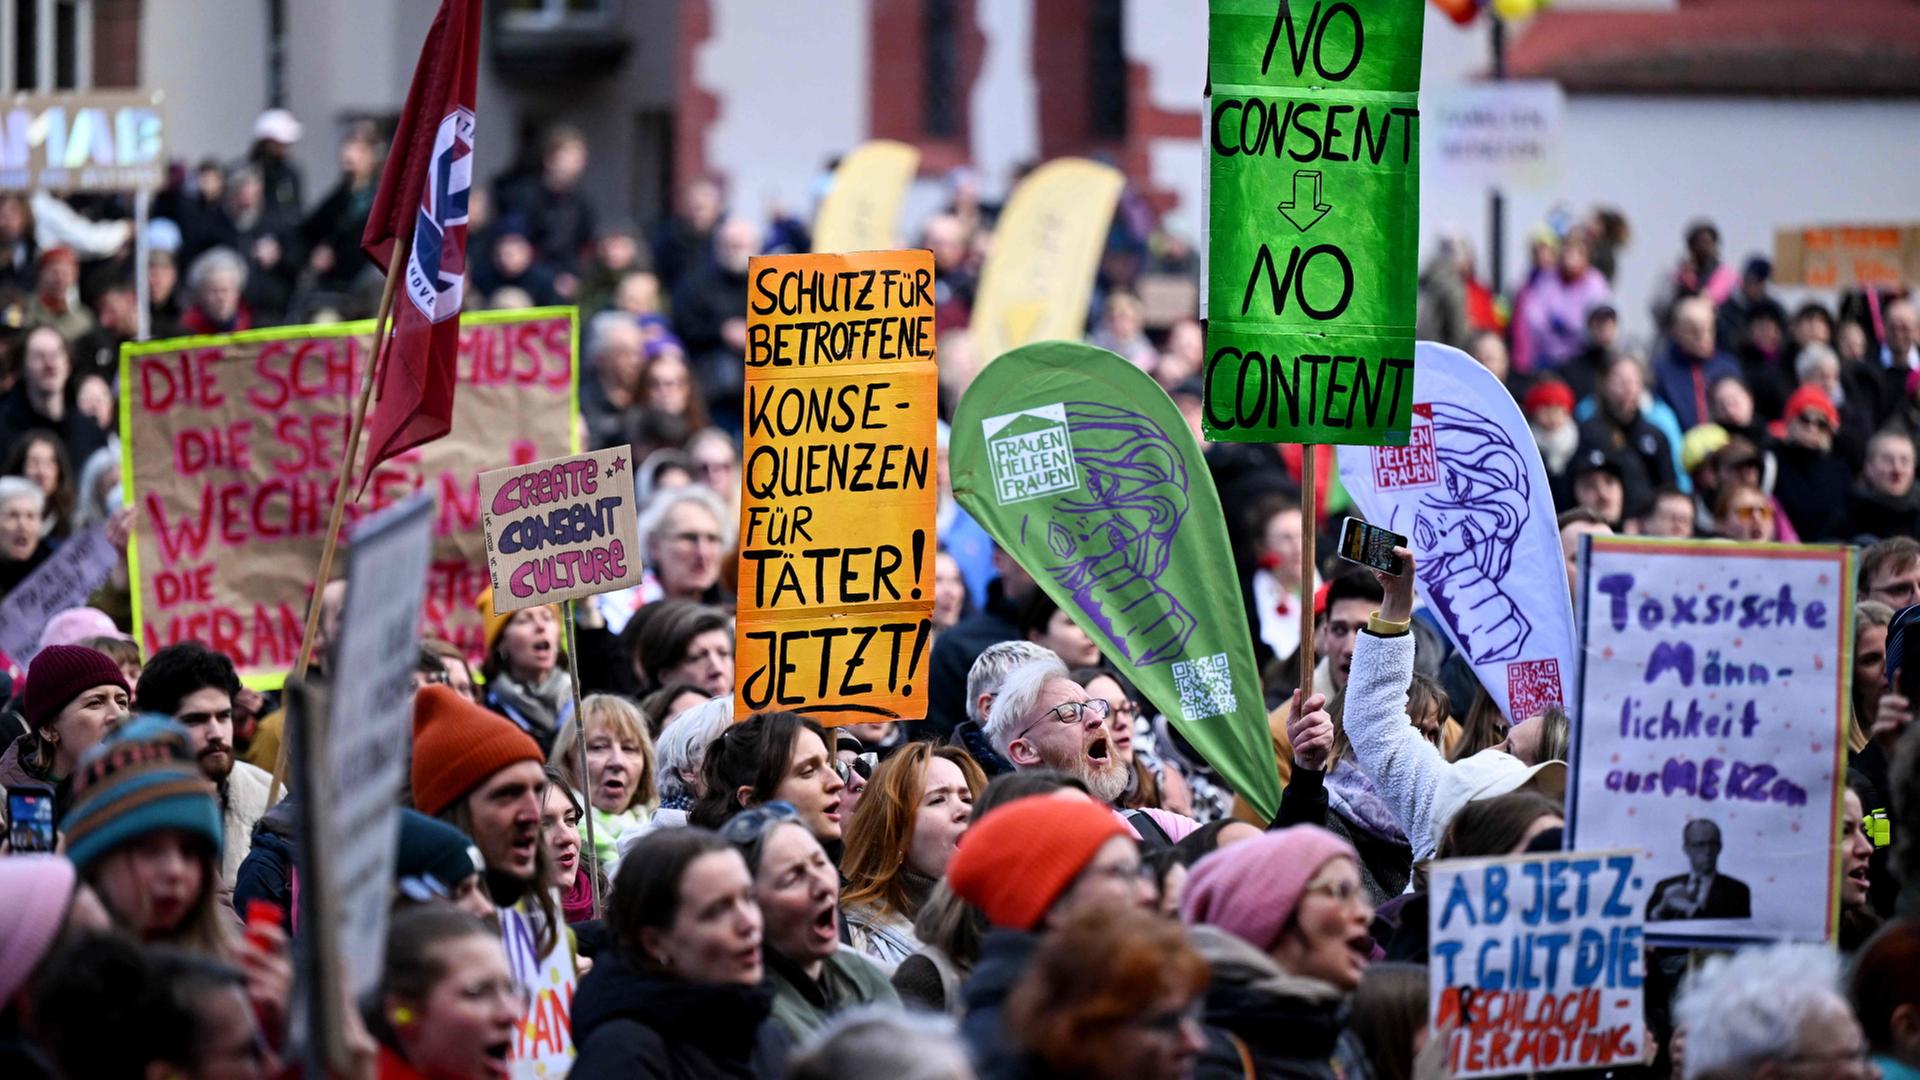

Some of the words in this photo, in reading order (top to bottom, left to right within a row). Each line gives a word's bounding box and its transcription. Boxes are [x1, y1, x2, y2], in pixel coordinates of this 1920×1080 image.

[1261, 0, 1364, 81] NO
[1211, 97, 1419, 165] CONSENT
[751, 268, 876, 315] SCHUTZ
[1242, 244, 1354, 320] NO
[141, 349, 225, 414] DIE
[247, 335, 361, 411] SCH
[456, 317, 571, 392] MUSS
[746, 316, 934, 367] BETROFFENE,
[1204, 346, 1414, 430] CONTENT
[176, 420, 252, 476] DIE
[747, 443, 929, 499] QUENZEN
[995, 430, 1062, 460] FRAUEN
[997, 450, 1067, 478] HELFEN
[1376, 446, 1432, 468] HELFEN
[1002, 467, 1071, 498] FRAUEN
[1379, 464, 1435, 487] FRAUEN
[747, 506, 812, 547] FÜR
[153, 563, 216, 609] DIE
[742, 529, 925, 608] TÄTER!
[1597, 572, 1827, 633] Toxsische
[742, 618, 931, 710] JETZT!
[1644, 641, 1794, 687] Männ-
[1619, 696, 1760, 741] lichkeit
[1439, 864, 1509, 930] AB
[1434, 939, 1464, 988] T
[1476, 932, 1572, 992] GILT
[1573, 926, 1643, 988] DIE
